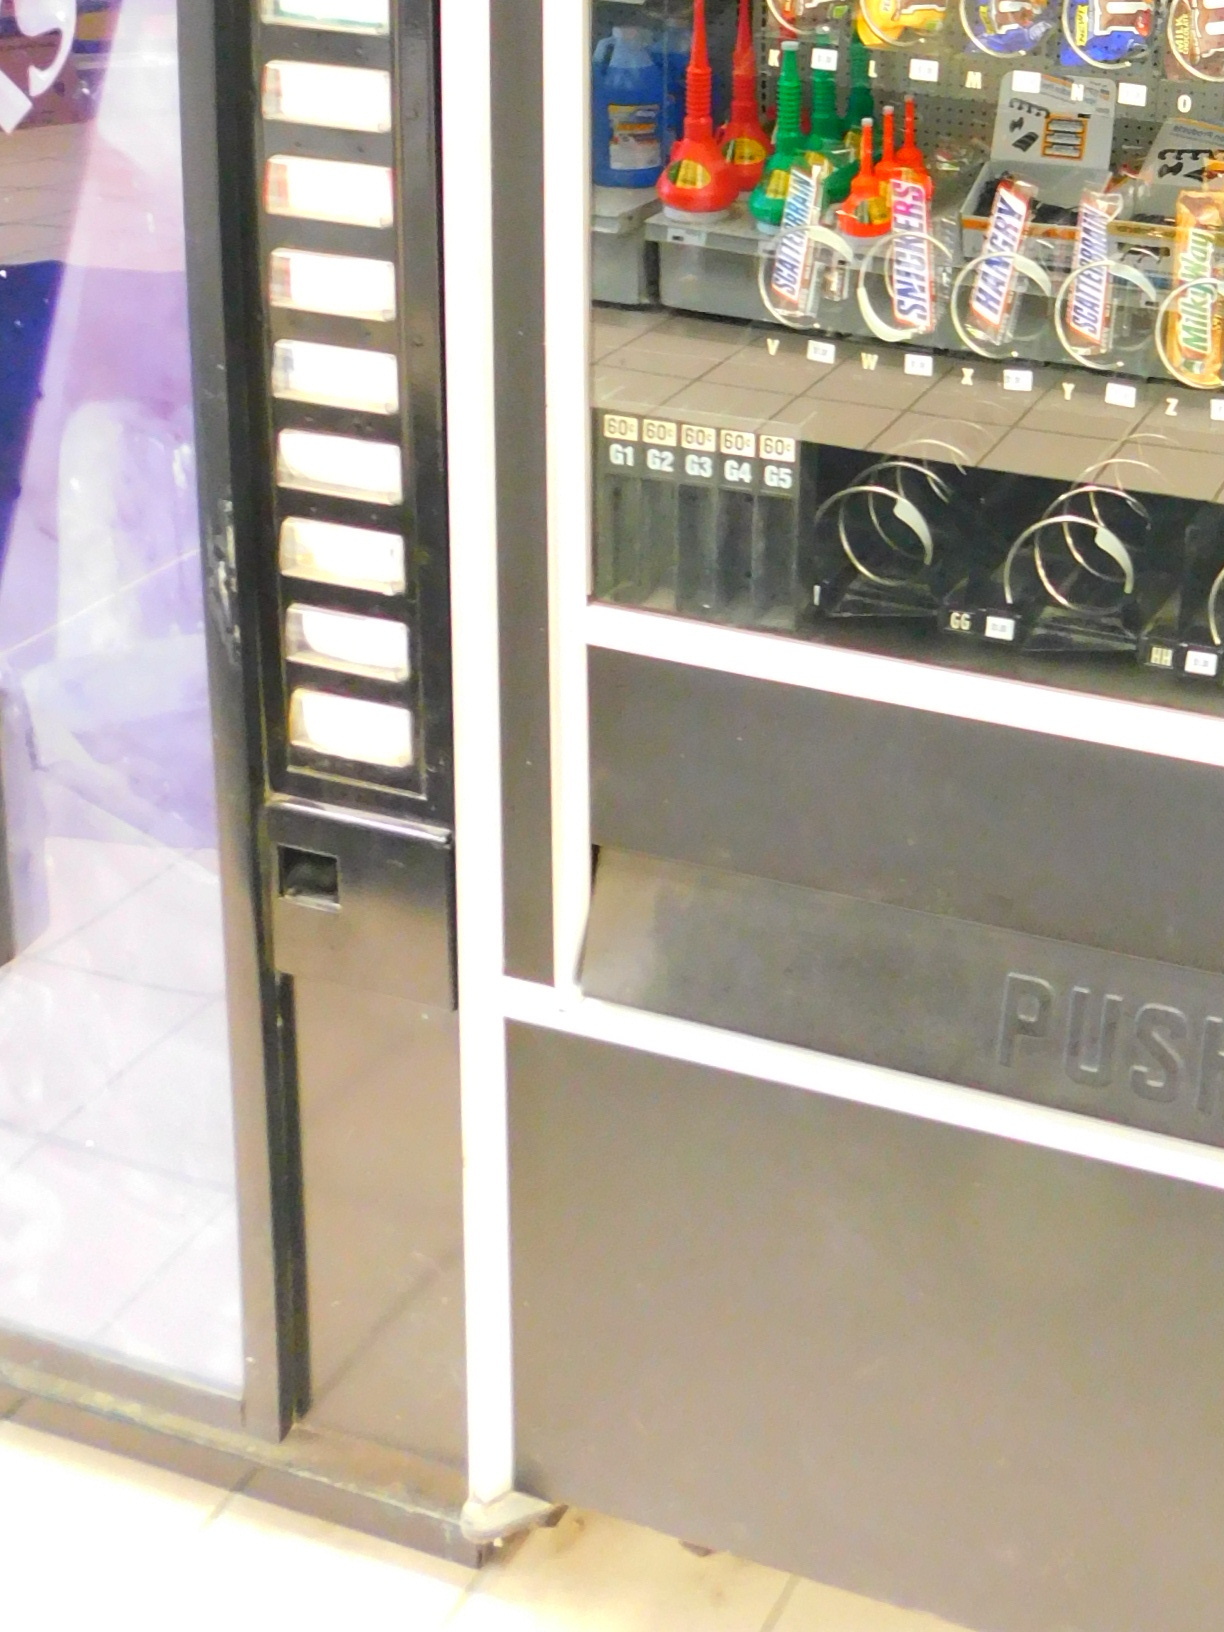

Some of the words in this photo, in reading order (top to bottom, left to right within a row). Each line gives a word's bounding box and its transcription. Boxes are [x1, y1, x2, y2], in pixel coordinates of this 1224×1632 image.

[1175, 16, 1184, 54] MILK
[965, 71, 982, 89] M
[774, 169, 814, 297] SCATTEBRAIN
[893, 181, 929, 325] SNICKERS
[976, 195, 1027, 316] HANGRY
[1180, 231, 1214, 282] Way
[1181, 284, 1216, 351] Milky
[766, 338, 780, 356] V
[861, 352, 879, 370] W
[961, 368, 974, 386] X
[1062, 382, 1075, 400] Y
[1165, 398, 1179, 416] Z
[609, 443, 635, 466] G1
[646, 449, 674, 472] G2
[685, 454, 713, 478] G3
[724, 459, 752, 483] G4
[764, 465, 792, 489] G5
[950, 612, 971, 631] GG
[1150, 646, 1173, 666] HH
